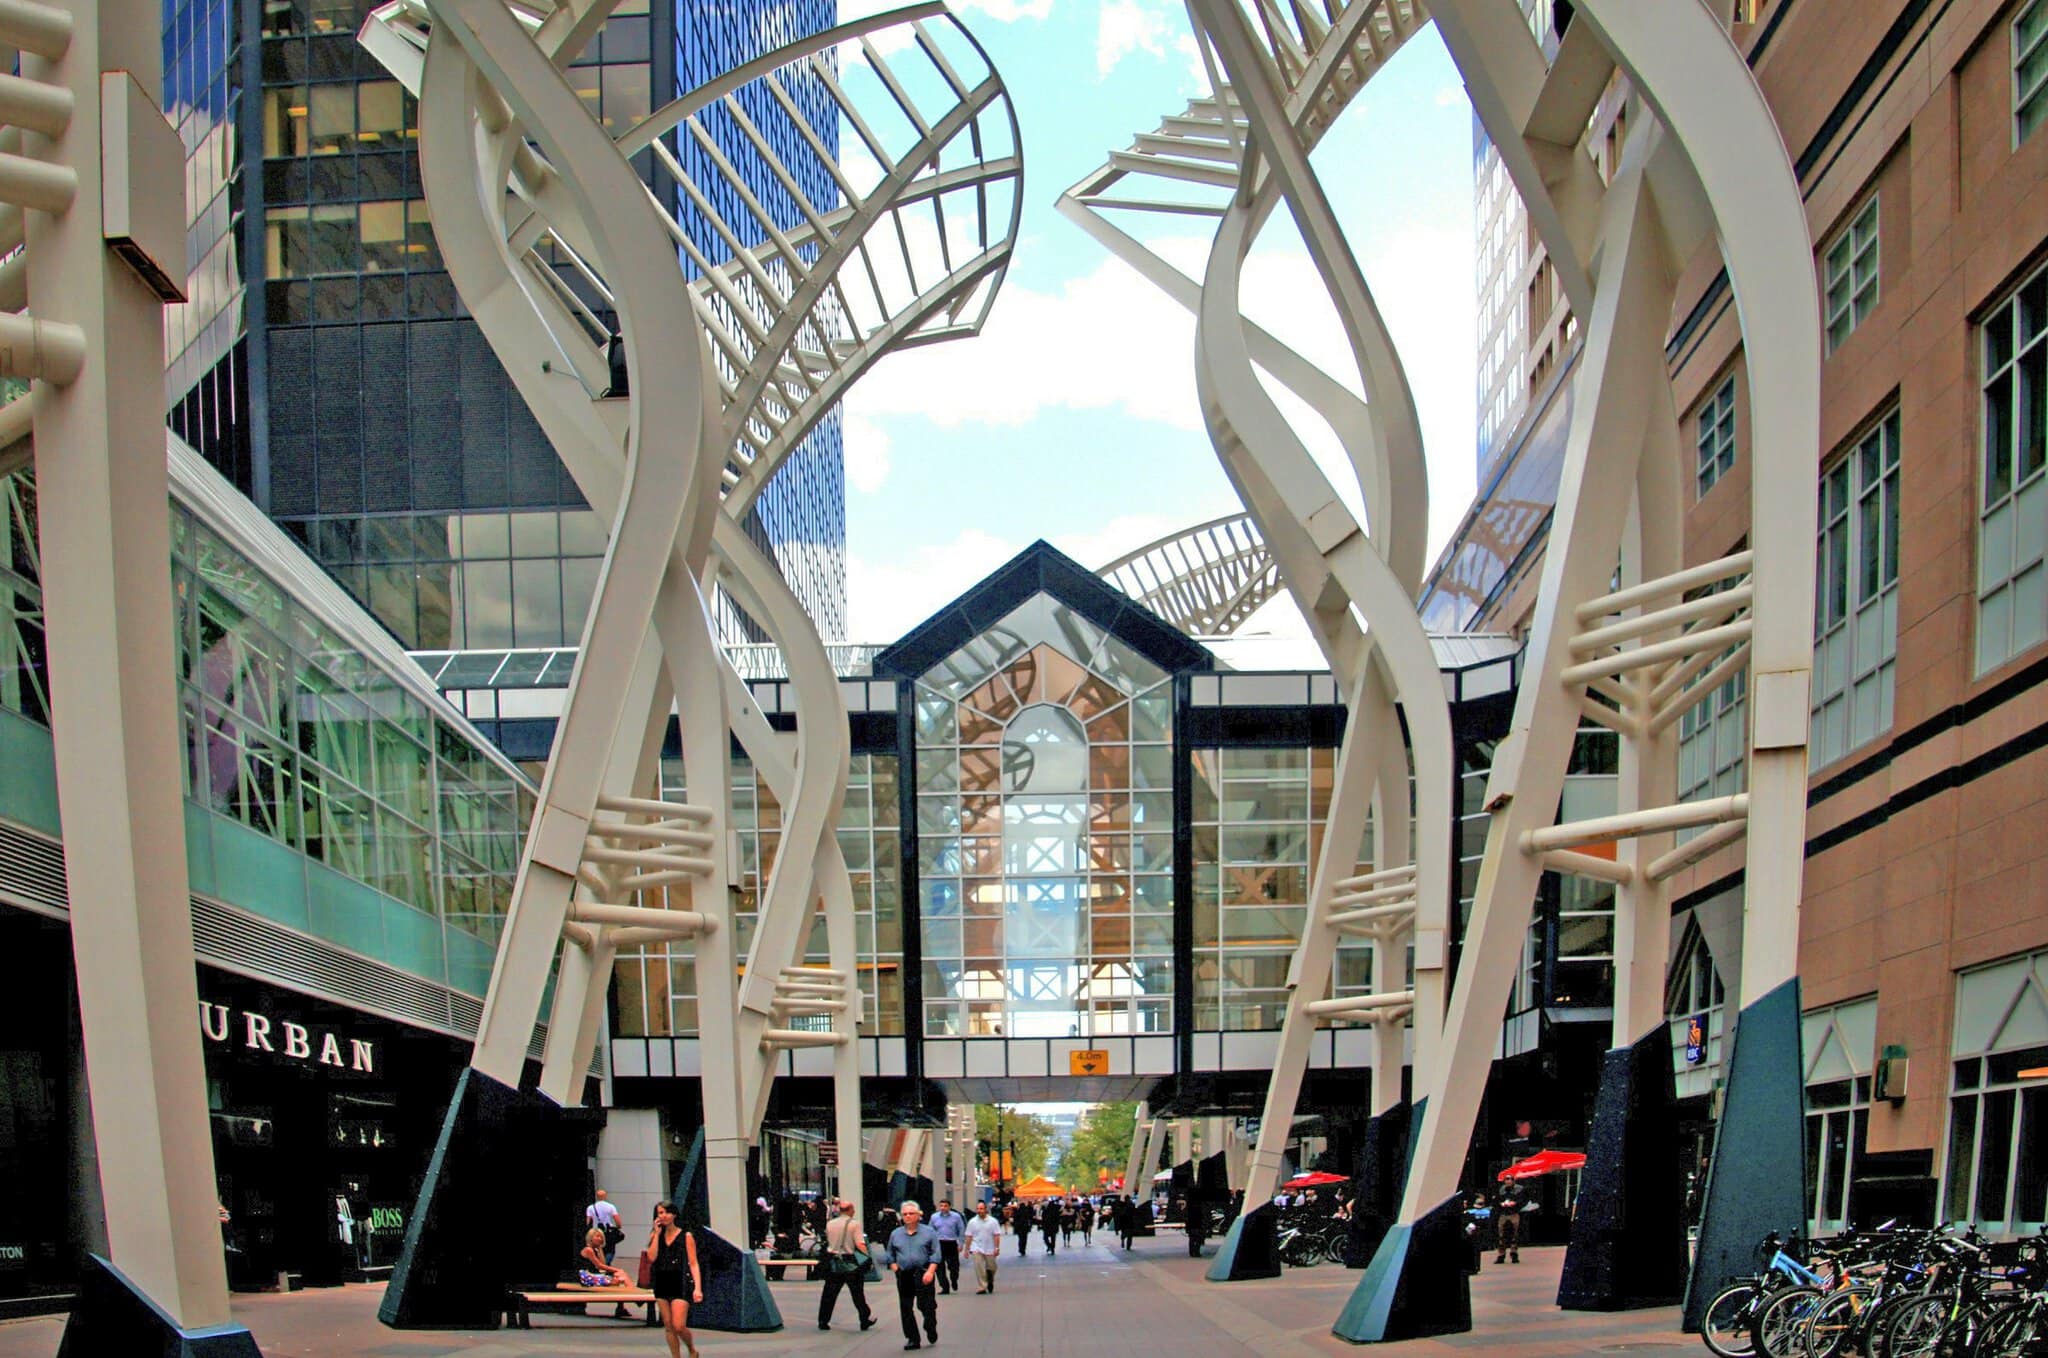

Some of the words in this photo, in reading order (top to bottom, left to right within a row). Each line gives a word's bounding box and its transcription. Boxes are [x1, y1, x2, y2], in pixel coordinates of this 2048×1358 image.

[199, 1001, 373, 1073] URBAN
[372, 1207, 403, 1228] BOSS
[0, 1246, 23, 1259] TON
